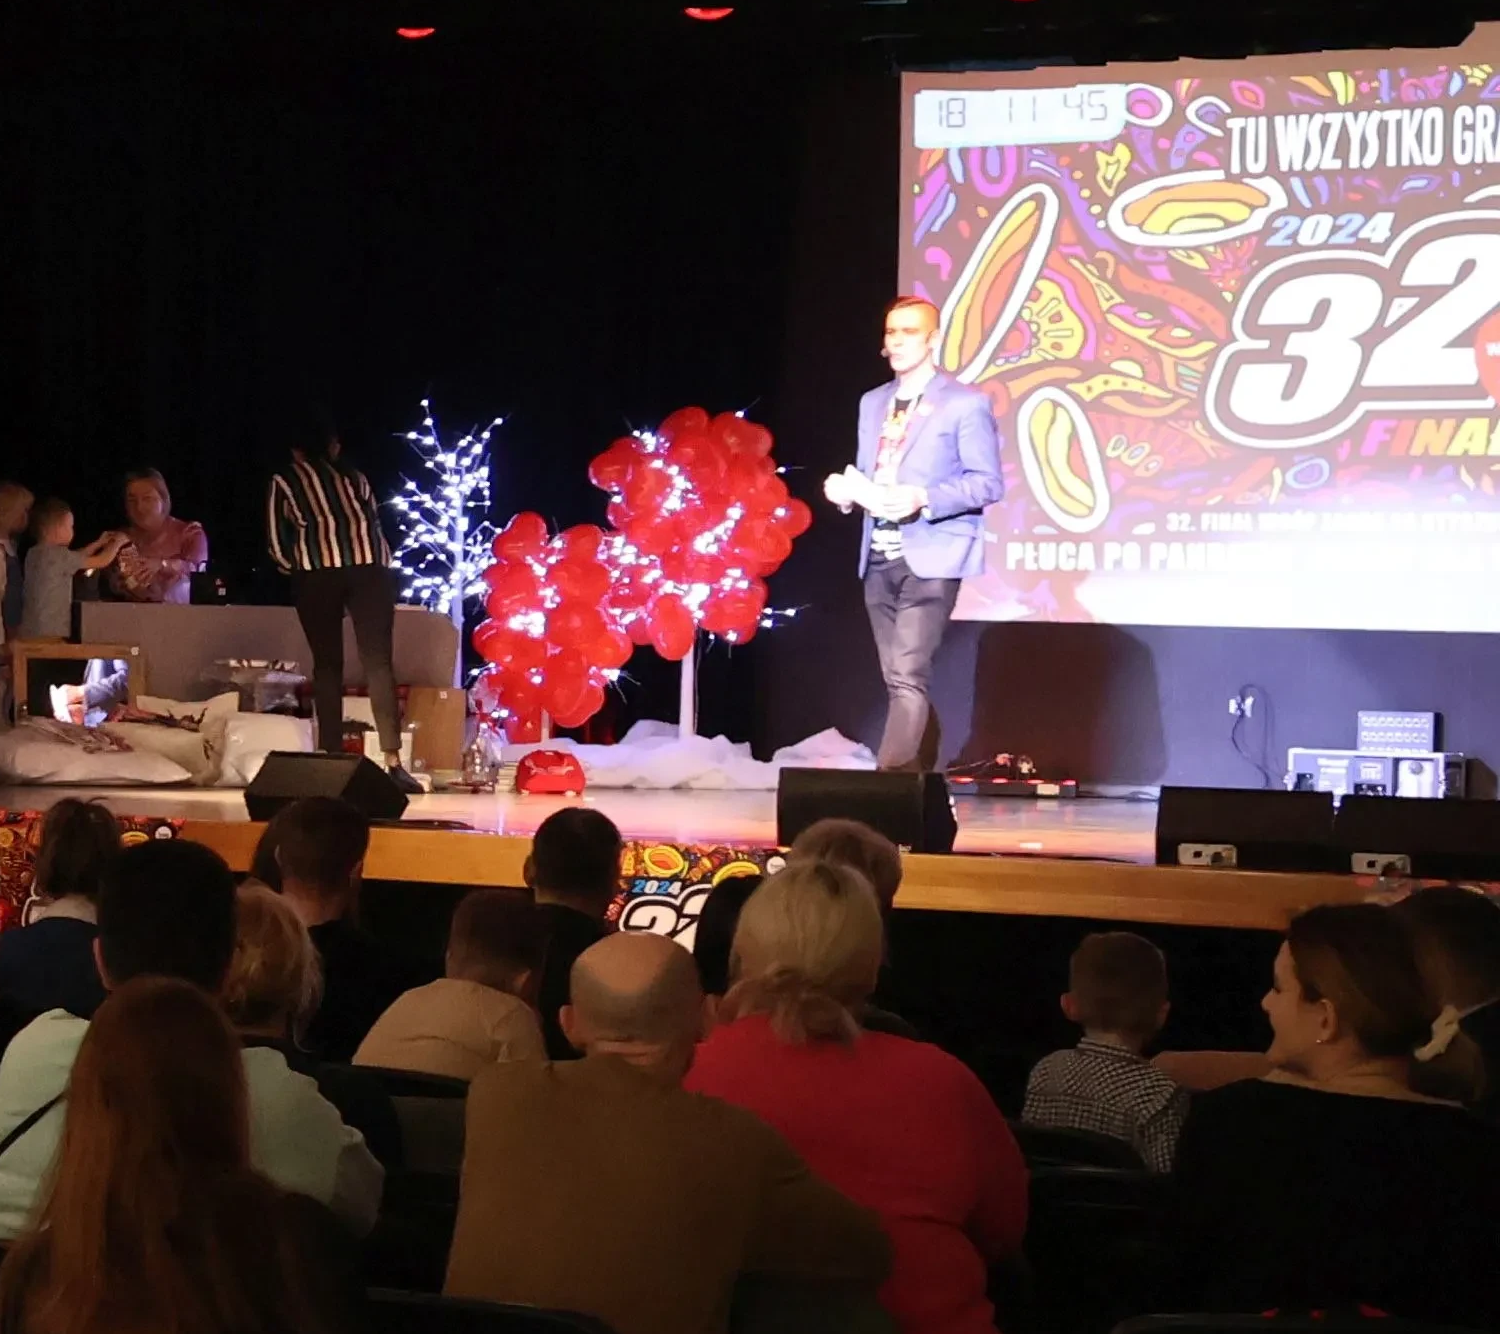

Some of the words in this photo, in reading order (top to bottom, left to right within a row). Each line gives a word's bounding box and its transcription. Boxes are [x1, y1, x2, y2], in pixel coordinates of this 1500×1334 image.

[938, 97, 966, 128] 18
[1063, 89, 1108, 121] 45
[1226, 116, 1268, 174] TU
[1274, 107, 1444, 172] WSZYSTKO
[1265, 212, 1395, 246] 2024
[1228, 232, 1500, 425] 32
[1165, 512, 1196, 532] 32.
[1006, 541, 1096, 571] PŁUCA
[1103, 541, 1142, 571] PO
[632, 879, 683, 895] 2024
